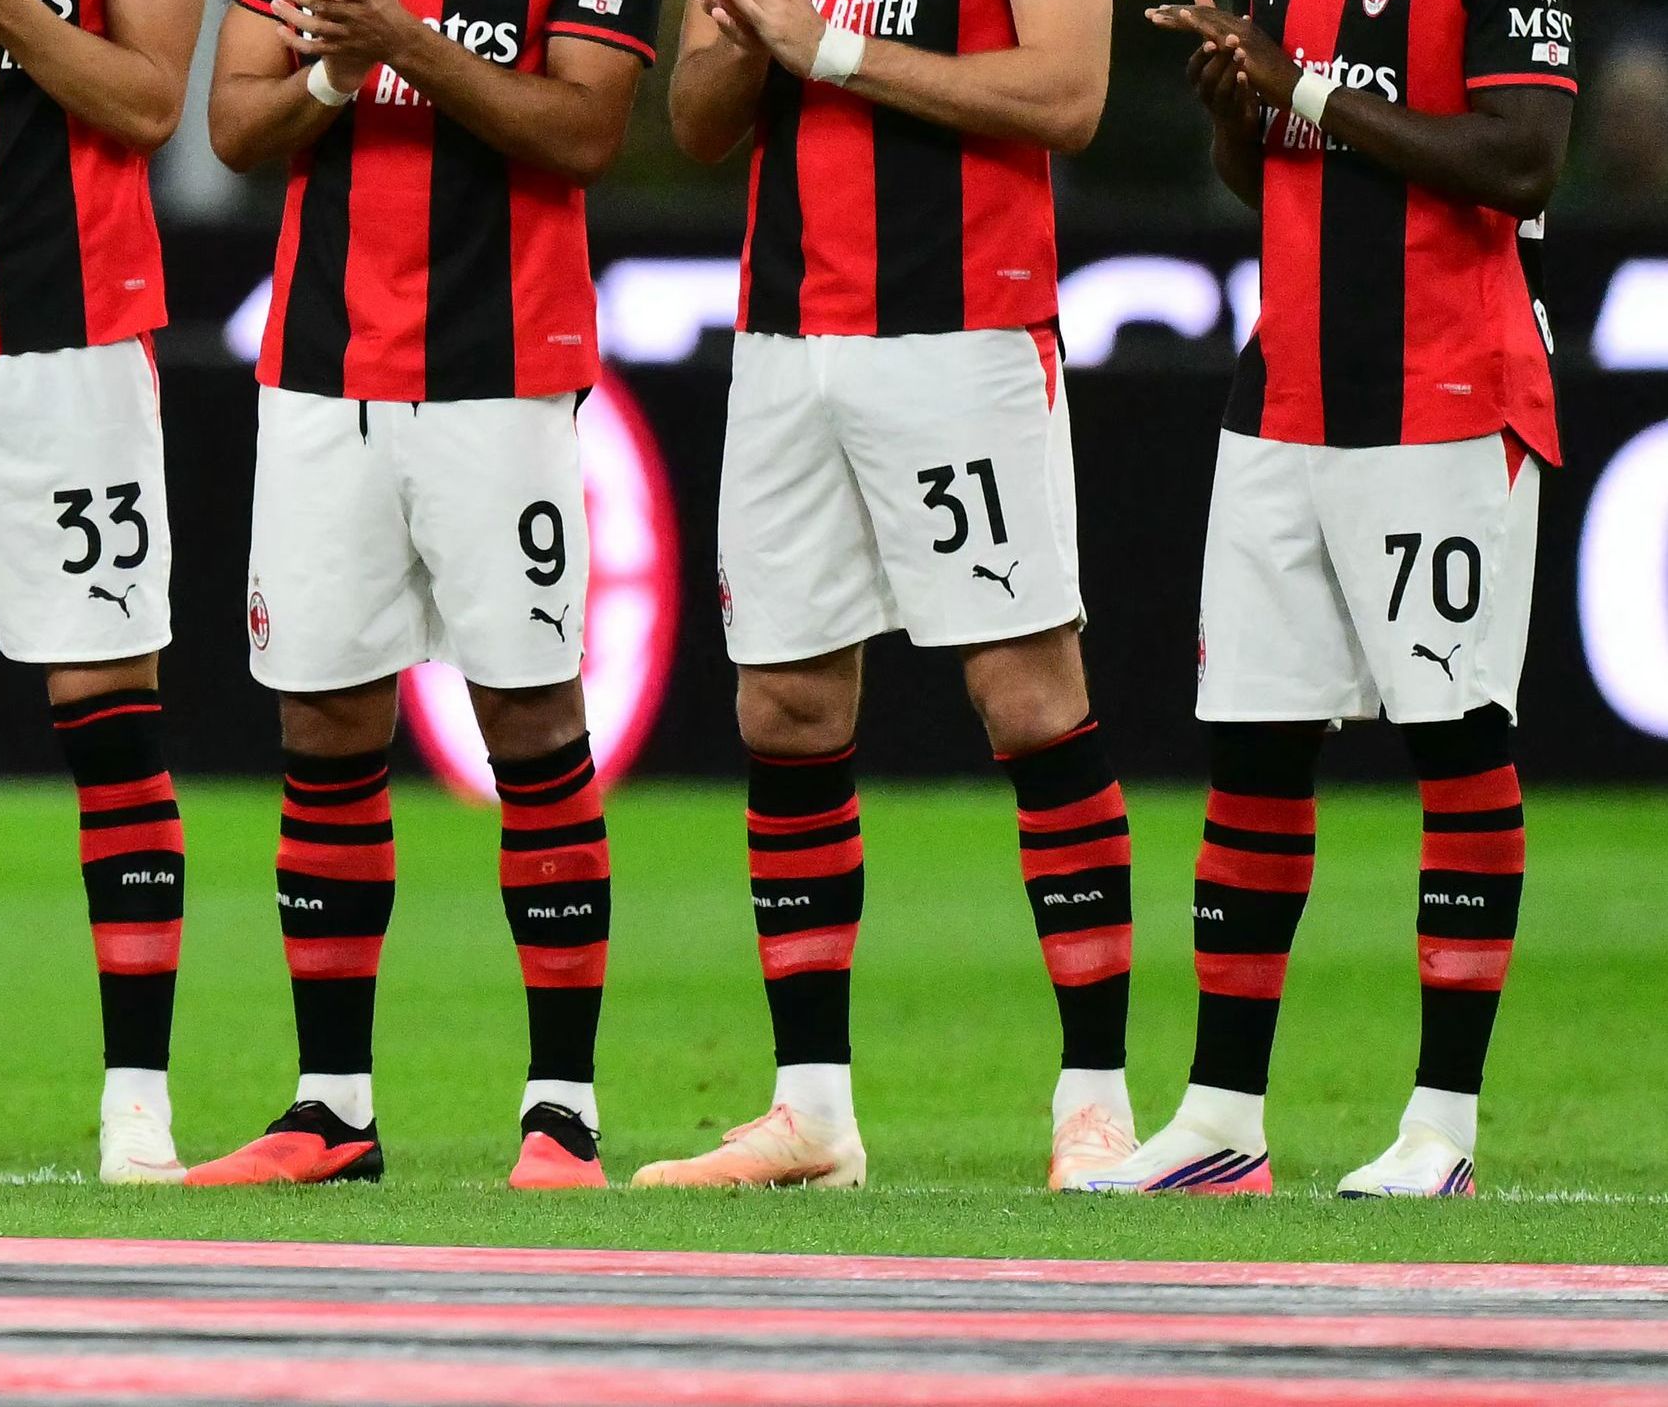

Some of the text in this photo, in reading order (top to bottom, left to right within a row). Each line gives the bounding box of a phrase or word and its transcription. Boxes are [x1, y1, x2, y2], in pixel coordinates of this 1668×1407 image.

[1508, 7, 1573, 43] MSC
[53, 481, 149, 575] 33
[517, 500, 566, 587] 9
[917, 458, 1009, 554] 31
[1384, 532, 1482, 623] 70
